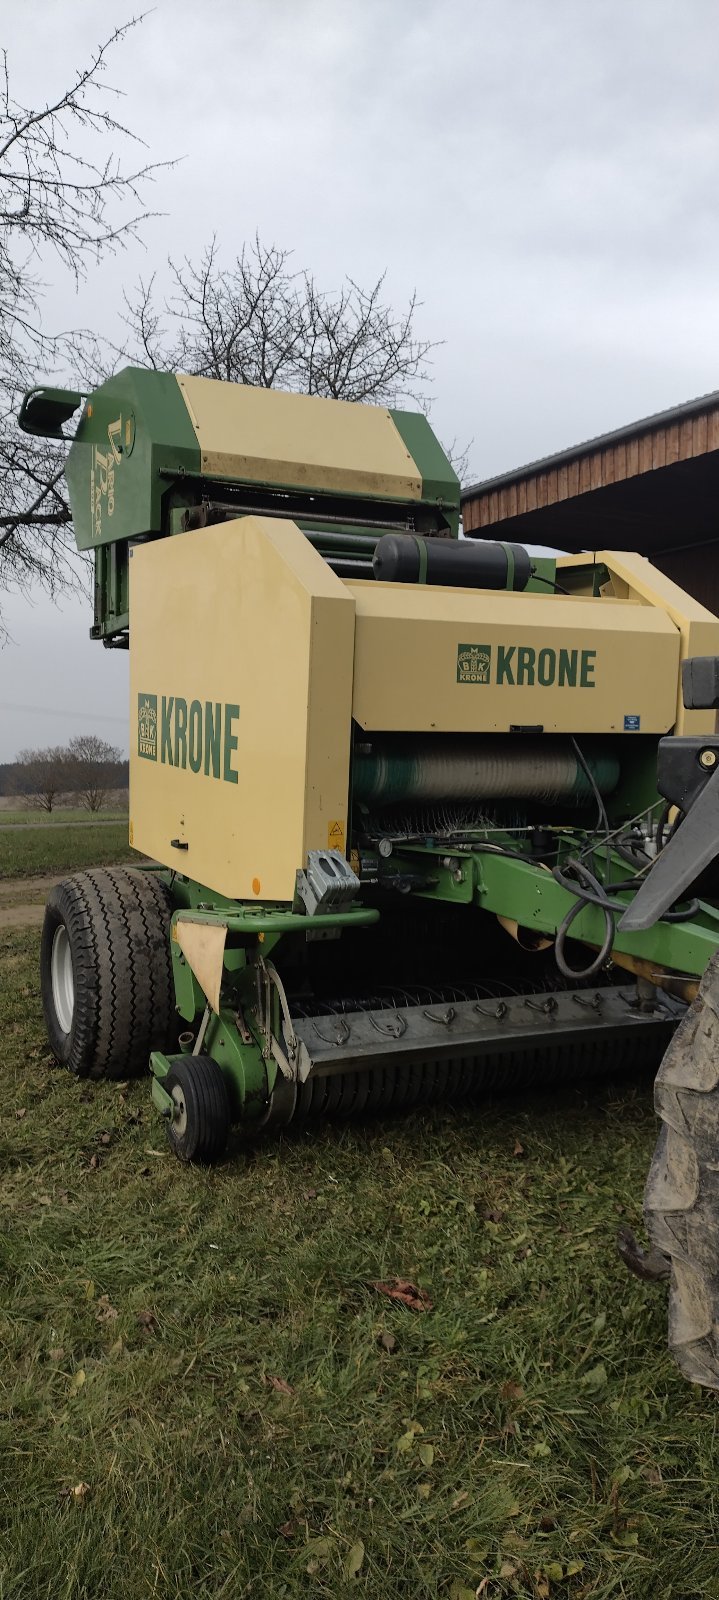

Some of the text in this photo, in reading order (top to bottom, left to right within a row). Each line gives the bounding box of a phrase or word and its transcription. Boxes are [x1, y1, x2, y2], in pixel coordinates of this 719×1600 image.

[95, 444, 108, 536] PACK
[459, 674, 487, 682] KRONE
[496, 645, 597, 688] KRONE
[161, 695, 240, 784] KRONE
